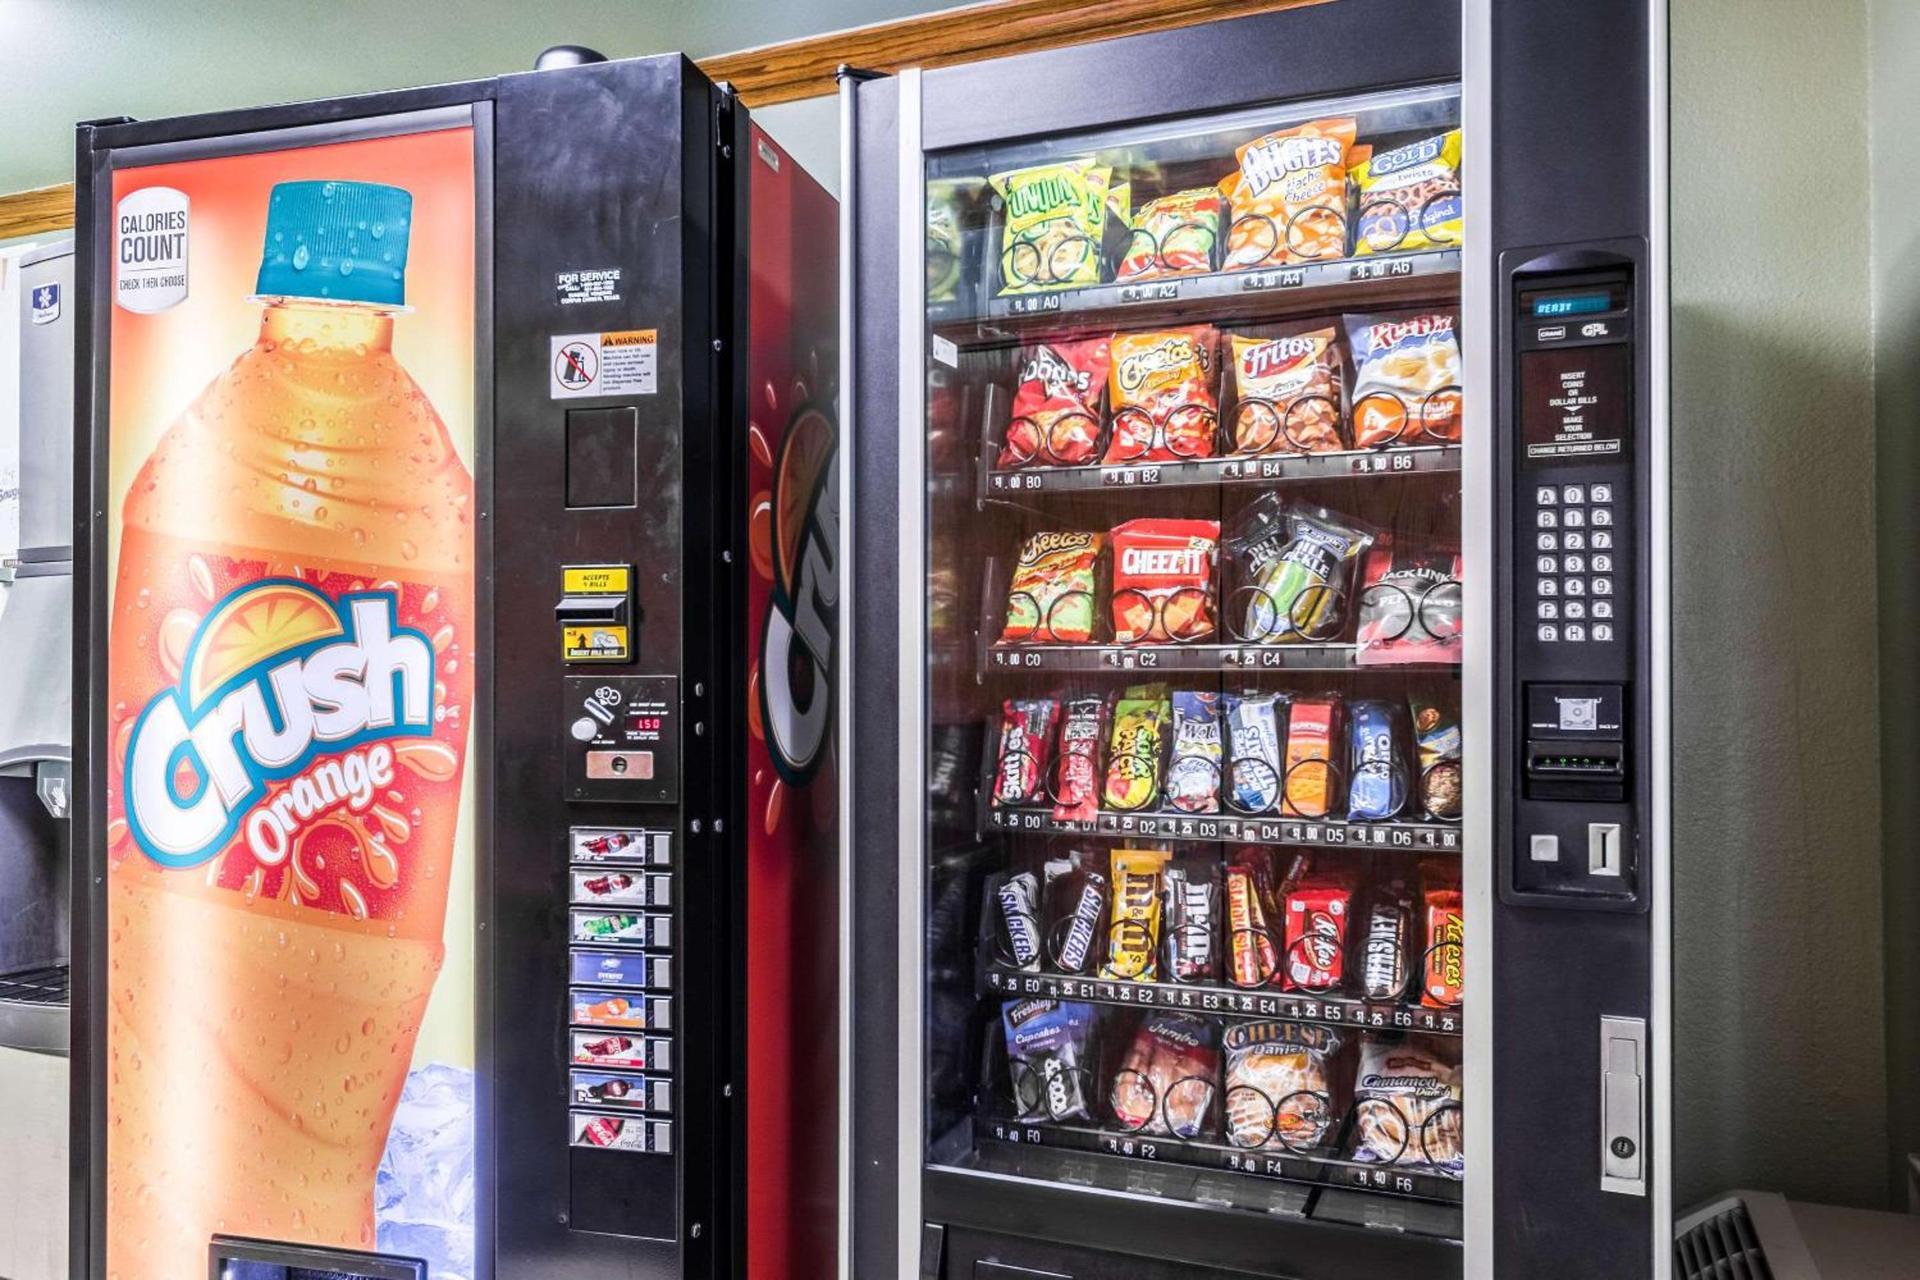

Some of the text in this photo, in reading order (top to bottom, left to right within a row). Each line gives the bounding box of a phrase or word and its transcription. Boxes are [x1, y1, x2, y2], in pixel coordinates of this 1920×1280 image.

[1373, 143, 1438, 174] GOLD
[121, 210, 185, 235] CALORIES
[121, 233, 185, 264] COUNT
[1391, 261, 1410, 273] A6
[559, 270, 620, 284] FOR SERVICE
[1283, 272, 1300, 285] A4
[120, 278, 140, 291] CHECK
[1159, 286, 1176, 297] A2
[1044, 297, 1059, 309] A0
[615, 335, 654, 346] WARNING
[1560, 371, 1586, 381] INSERT
[1562, 380, 1584, 389] COINS
[1549, 396, 1598, 407] DOLLAR BILLS
[1563, 415, 1584, 424] MAKE
[1555, 432, 1593, 441] SELECTION
[1393, 456, 1412, 470] B6
[1142, 470, 1159, 483] B2
[1263, 463, 1281, 477] B4
[1026, 475, 1042, 489] B0
[1026, 653, 1041, 666] C0
[1140, 653, 1157, 666] C2
[1263, 653, 1280, 665] C4
[131, 598, 431, 855] Crush
[1002, 726, 1024, 800] Skittes
[247, 744, 395, 864] Orange
[1025, 816, 1041, 829] D0
[1140, 822, 1156, 834] D2
[1200, 823, 1217, 836] D3
[1262, 826, 1279, 839] D4
[1327, 829, 1344, 842] D5
[1393, 832, 1412, 845] D6
[1065, 888, 1102, 970] SNICKERS
[1026, 979, 1040, 992] E0
[1081, 984, 1094, 997] E1
[1139, 990, 1153, 1003] E2
[1203, 995, 1218, 1009] E3
[1260, 1001, 1276, 1014] E4
[1325, 1006, 1341, 1020] E5
[1395, 1012, 1412, 1026] E6
[1361, 1074, 1438, 1089] Cinnamon
[1414, 1085, 1451, 1098] Danish
[1028, 1130, 1040, 1143] F0
[1142, 1144, 1156, 1159] F2
[1267, 1161, 1282, 1175] F4
[1396, 1177, 1413, 1192] F6
